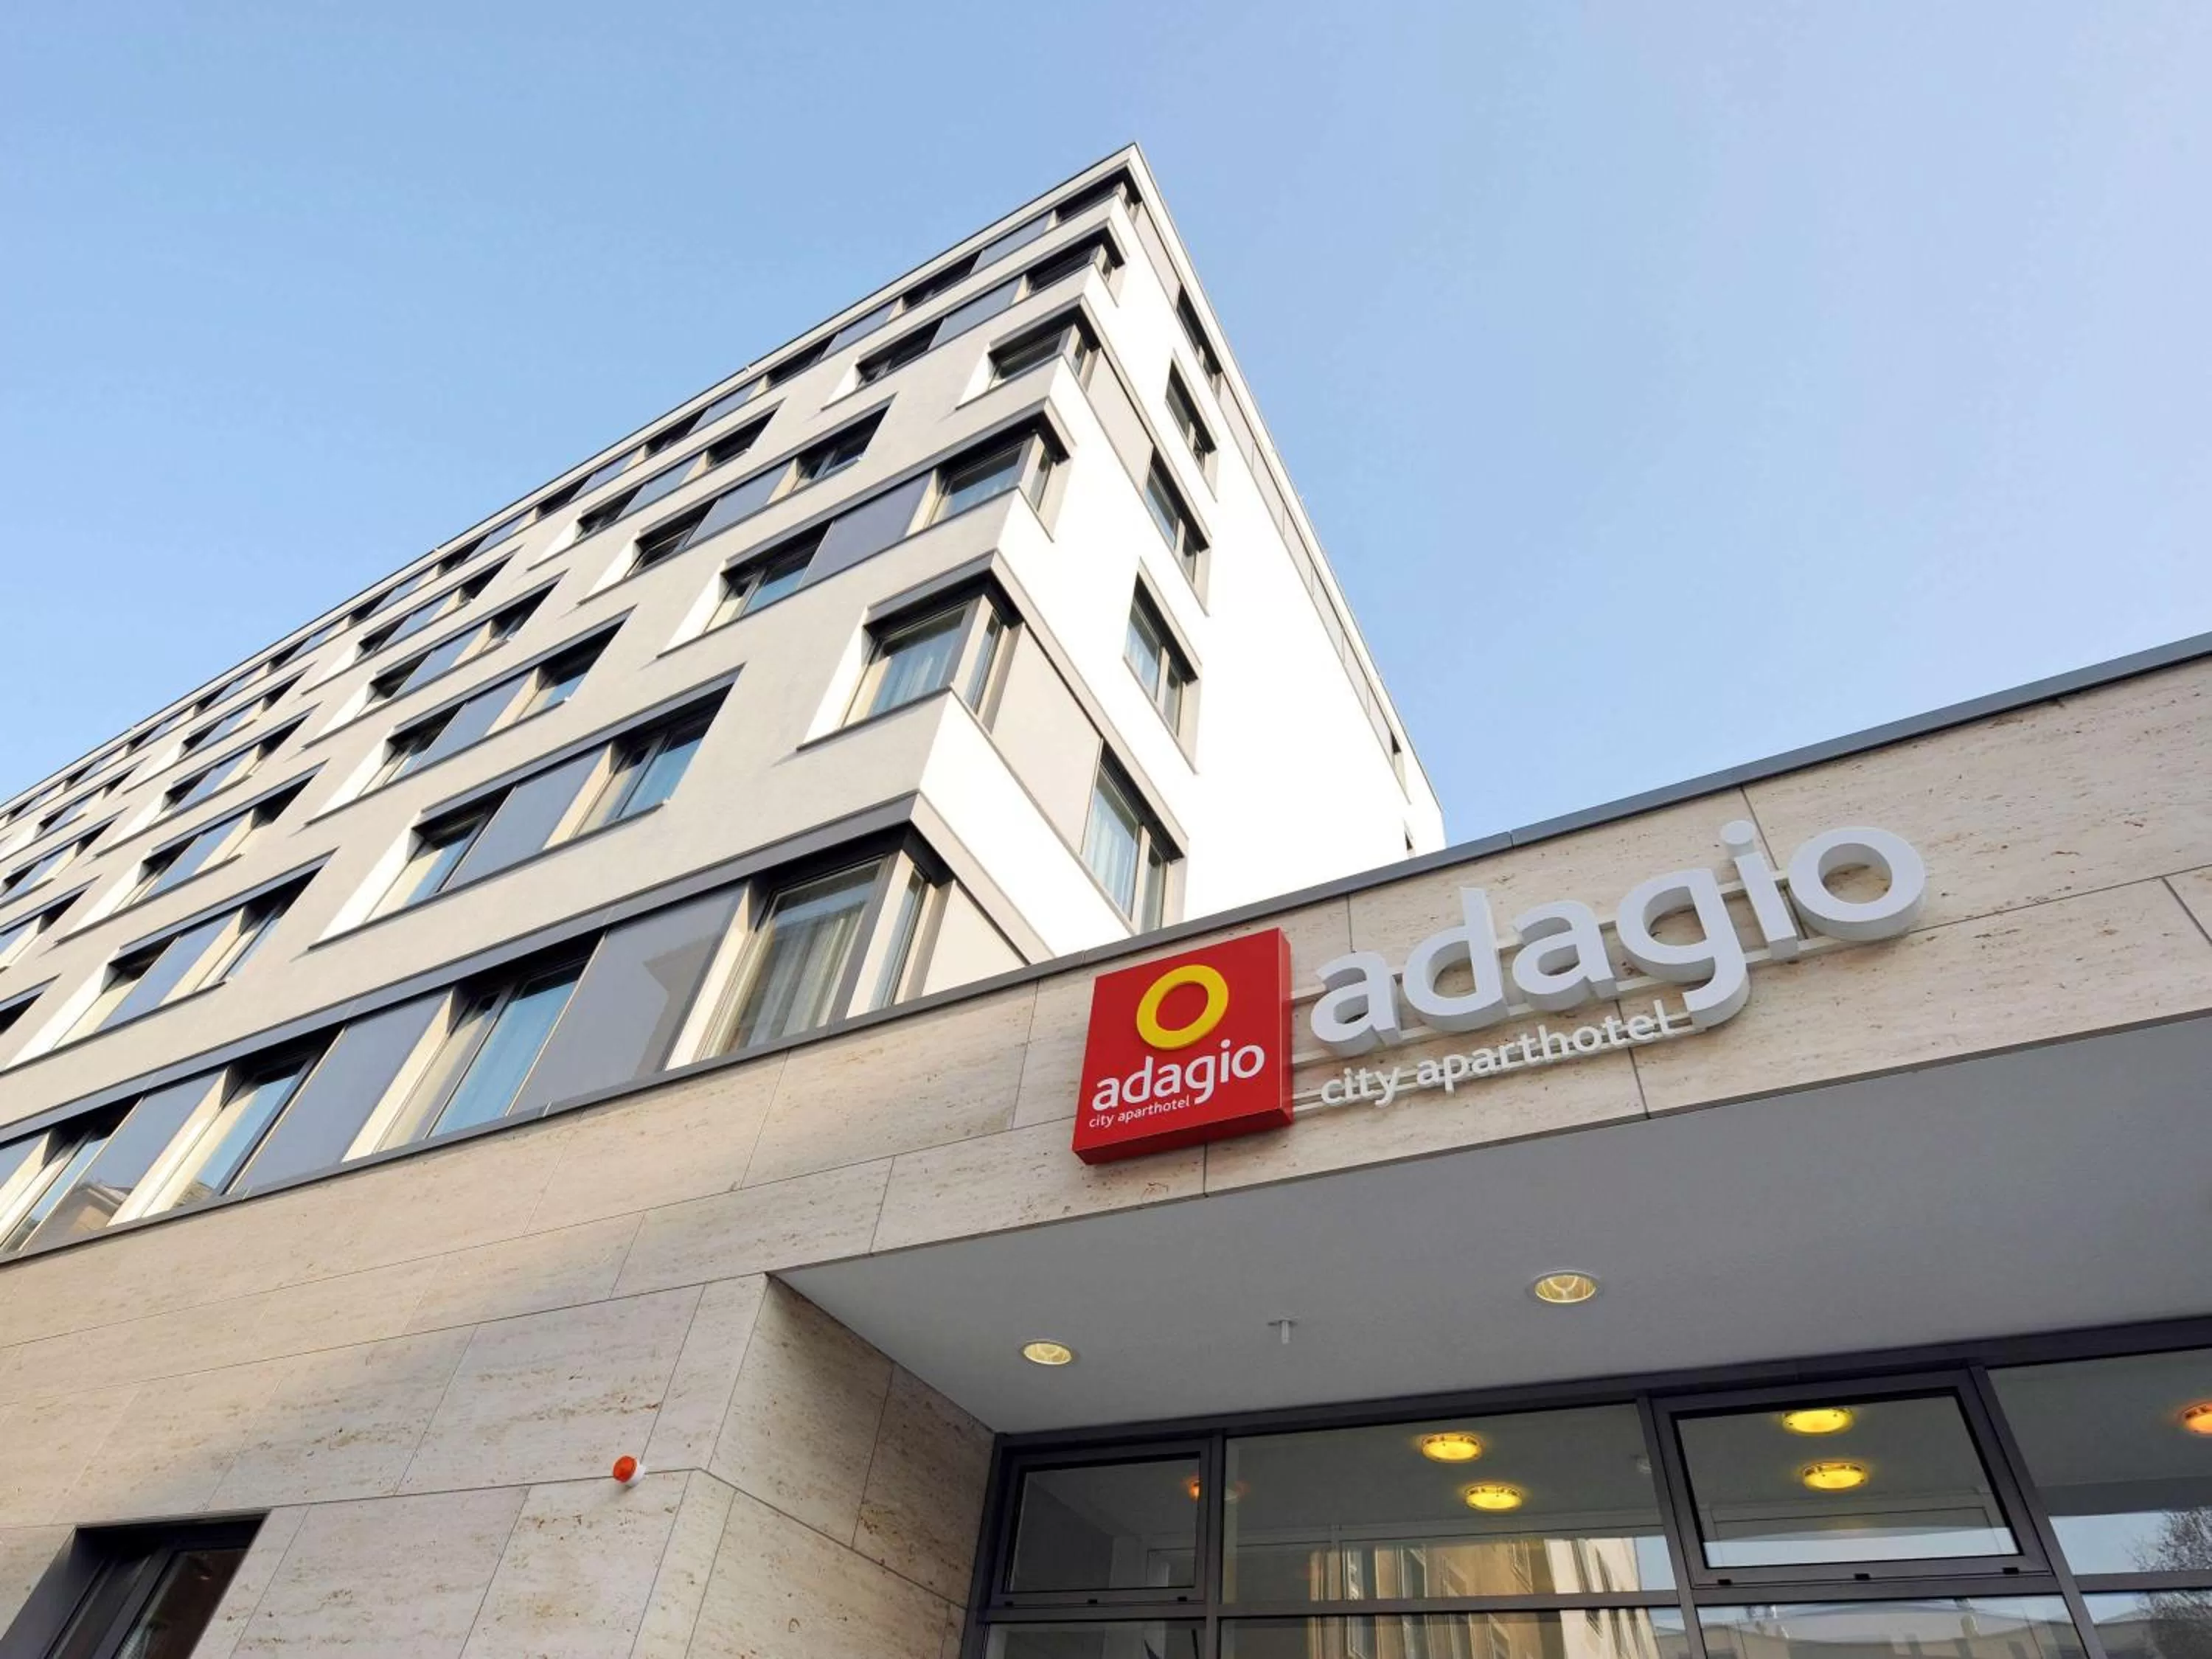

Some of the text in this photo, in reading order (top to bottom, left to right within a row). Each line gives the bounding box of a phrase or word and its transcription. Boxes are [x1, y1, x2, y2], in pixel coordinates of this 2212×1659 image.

[1310, 819, 1927, 1055] adagio
[1091, 1038, 1265, 1111] adagio
[1320, 999, 1673, 1107] city aparthotel
[1088, 1093, 1190, 1128] city aparthotel
